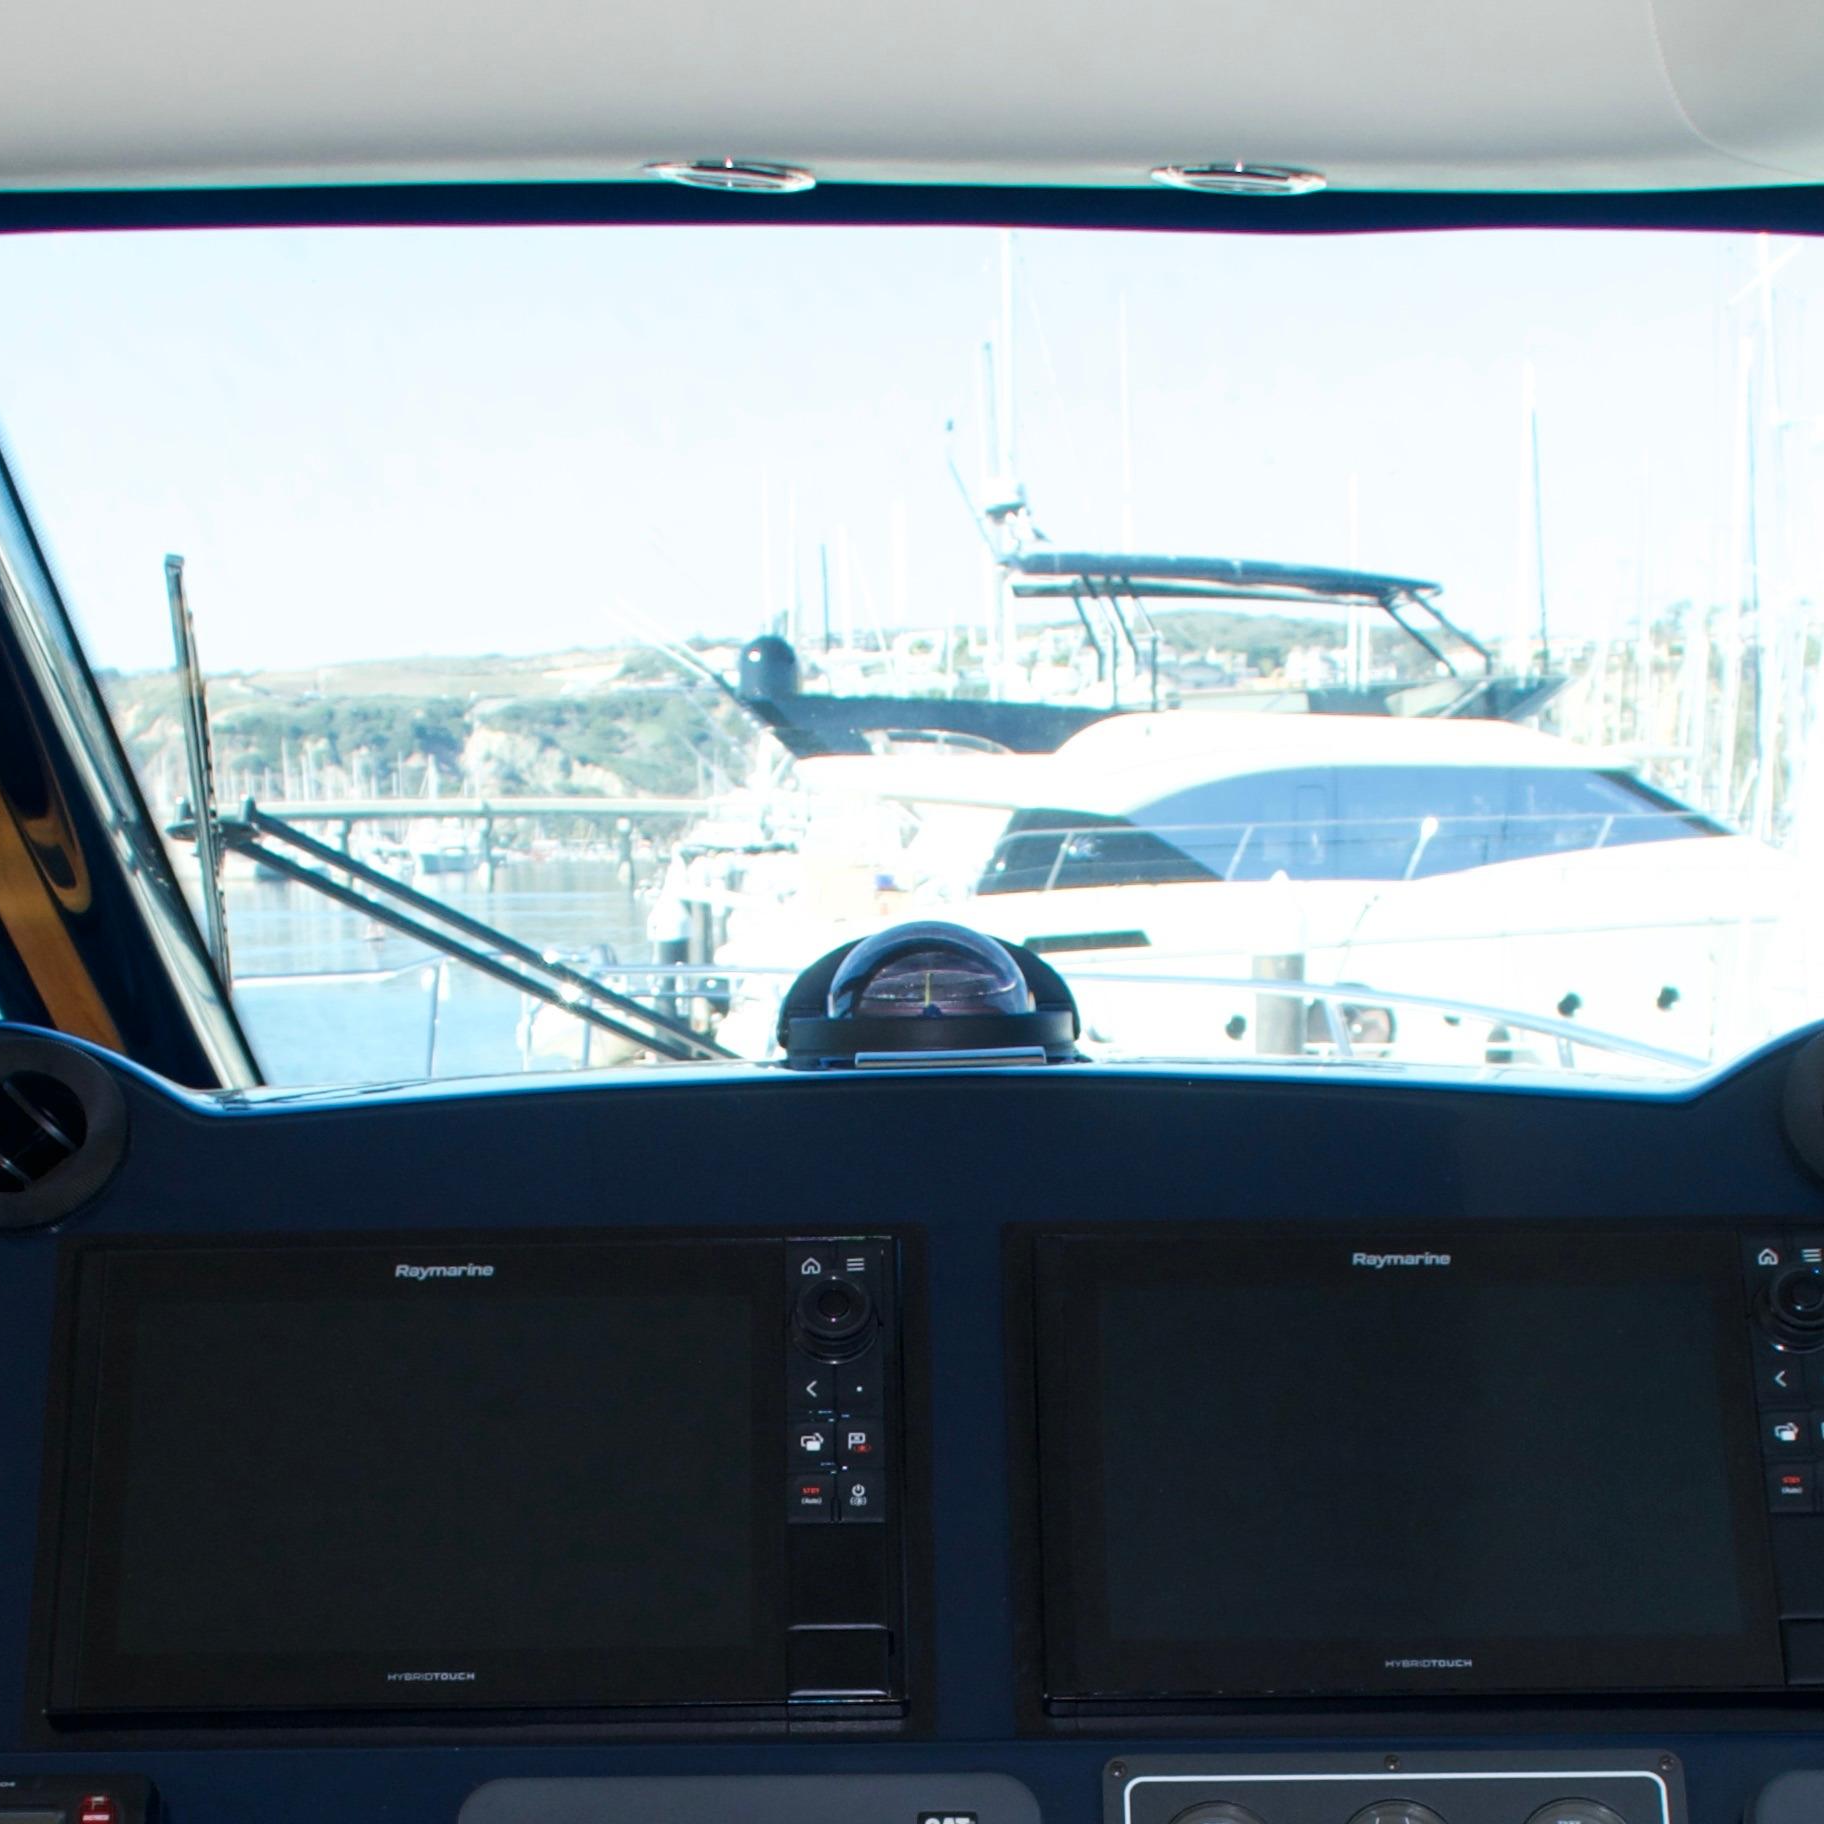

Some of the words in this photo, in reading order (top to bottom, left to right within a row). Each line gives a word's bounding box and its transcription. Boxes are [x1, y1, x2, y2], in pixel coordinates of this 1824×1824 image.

[1351, 1251, 1450, 1269] Raymarine
[394, 1262, 495, 1281] Raymarine
[1384, 1658, 1473, 1668] HYBRIDTOUCH
[386, 1671, 476, 1681] HYBRIDTOUCH
